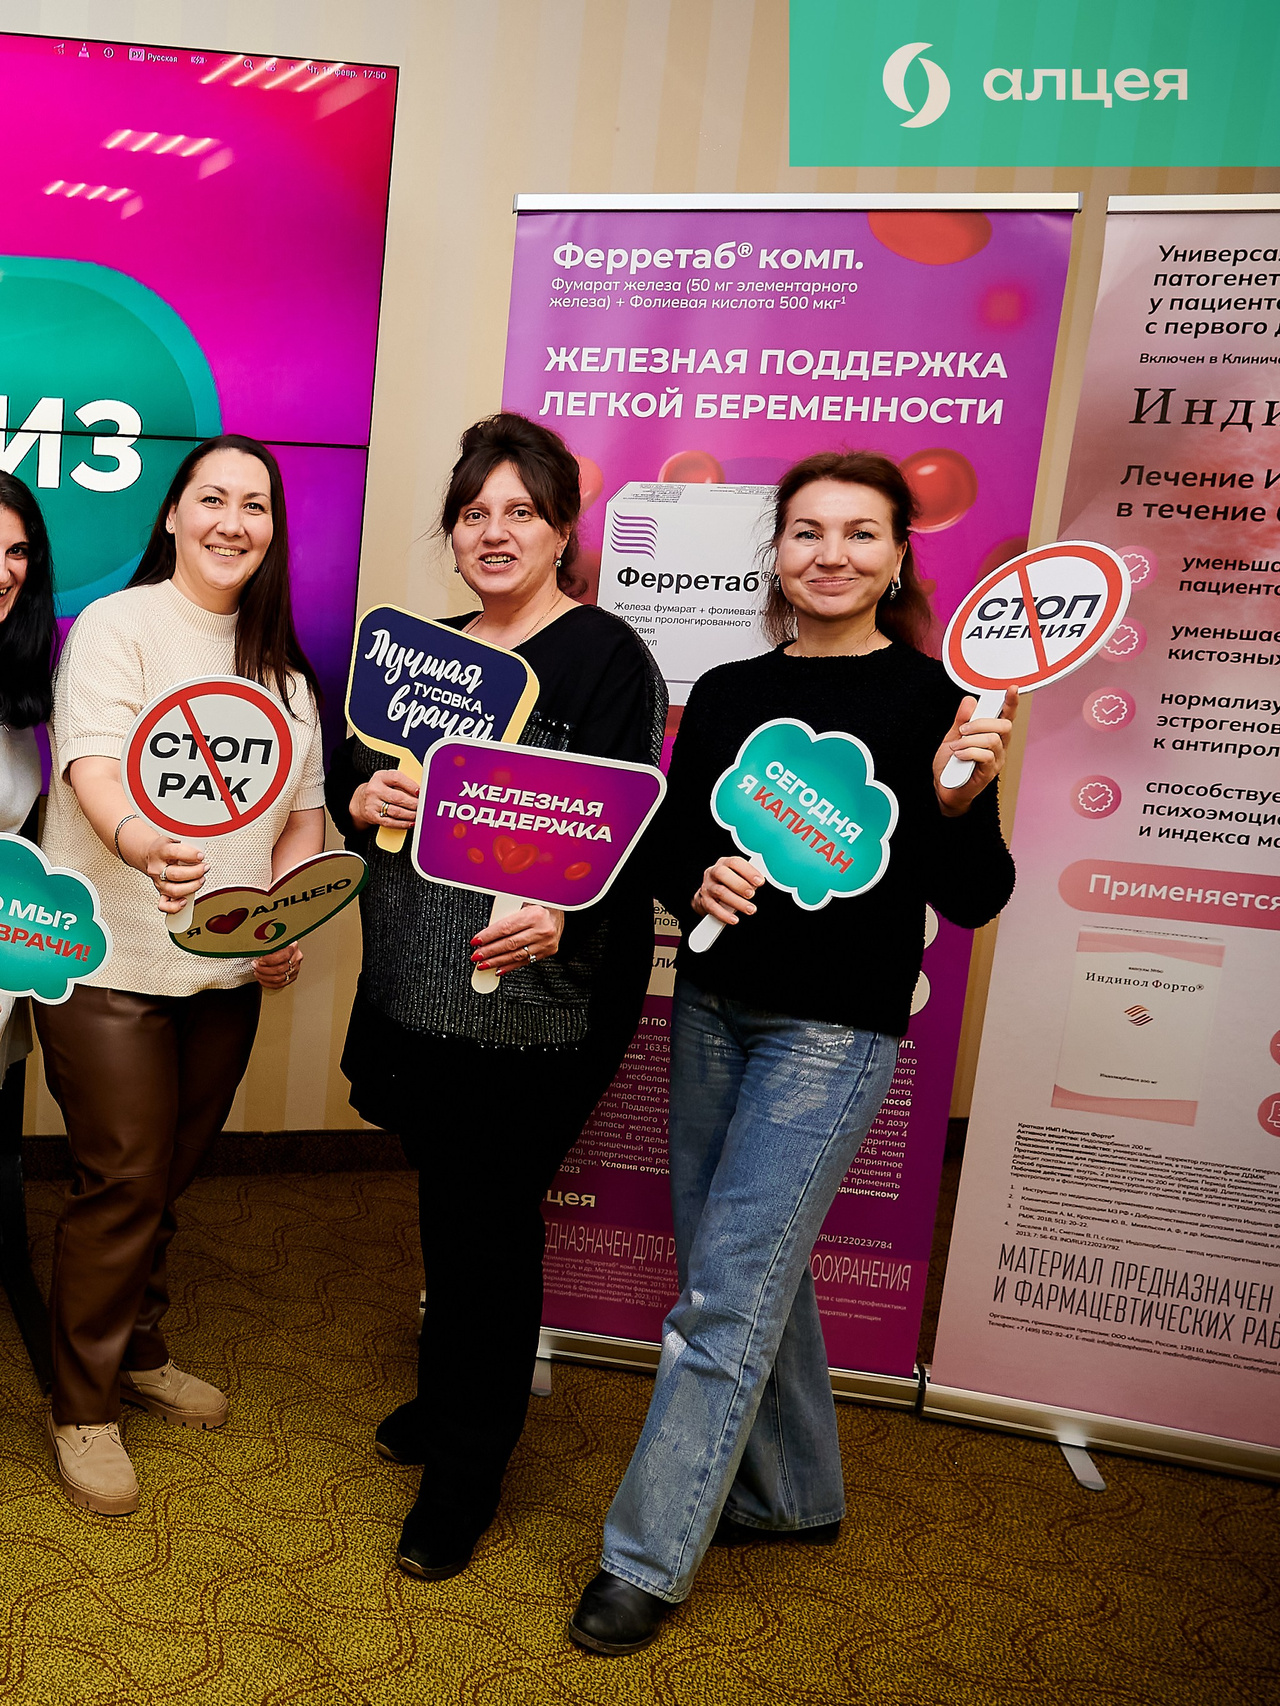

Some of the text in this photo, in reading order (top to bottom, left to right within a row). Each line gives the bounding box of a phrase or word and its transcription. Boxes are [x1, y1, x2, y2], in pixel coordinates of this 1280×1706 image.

[147, 53, 178, 63] Русская
[759, 246, 865, 271] комп.
[1159, 245, 1280, 266] Универса
[551, 277, 858, 296] Фумарат железа (50 мг элементарного
[549, 294, 613, 312] железа)
[615, 298, 625, 308] +
[630, 294, 707, 311] Фолиевая
[711, 296, 776, 310] кислота
[779, 296, 810, 310] 500
[1148, 297, 1163, 315] у
[1145, 321, 1158, 334] с
[1164, 321, 1268, 339] первого
[544, 345, 1008, 381] ЖЕЛЕЗНАЯ ПОДДЕРЖКА
[1139, 353, 1205, 364] Включен
[1209, 355, 1218, 364] в
[539, 386, 1004, 426] ЛЕГКОЙ БЕРЕМЕННОСТИ
[1120, 465, 1255, 489] Лечение
[1116, 502, 1133, 517] в
[1143, 502, 1266, 522] течение
[614, 602, 651, 611] Железа
[654, 603, 695, 614] фумарат
[708, 605, 756, 616] фолиевая
[977, 594, 1102, 622] СТОП
[655, 616, 751, 628] пролонгированного
[364, 629, 482, 692] Лучшая
[413, 681, 482, 715] ТУСОВКА
[387, 684, 496, 741] врачей
[149, 732, 273, 765] СТОП
[1153, 737, 1166, 749] к
[157, 772, 252, 803] РАК
[458, 781, 604, 818] ЖЕЛЕЗНАЯ
[765, 761, 863, 844] СЕГОДНЯ
[436, 800, 612, 842] ПОДДЕРЖКА
[737, 774, 854, 874] Я КАПИТАН
[1139, 825, 1251, 846] и индекса
[8, 899, 78, 931] МЫ?
[186, 878, 352, 939] Я АЛЦЕЮ
[1085, 971, 1149, 988] Индинол
[651, 1017, 667, 1027] ПО
[593, 1120, 662, 1134] запасы железа
[600, 1111, 658, 1123] нормального
[886, 1119, 909, 1129] дозу
[901, 1130, 908, 1138] 4
[588, 1149, 653, 1163] аллергические
[600, 1160, 638, 1171] Условия
[559, 1165, 581, 1174] 2023
[851, 1177, 901, 1189] применять
[633, 1233, 664, 1265] ДЛЯ
[998, 1243, 1274, 1314] МАТЕРИАЛ ПРЕДНАЗНАЧЕН
[993, 1275, 1007, 1303] И
[1014, 1279, 1236, 1342] ФАРМАЦЕВТИЧЕСКИХ
